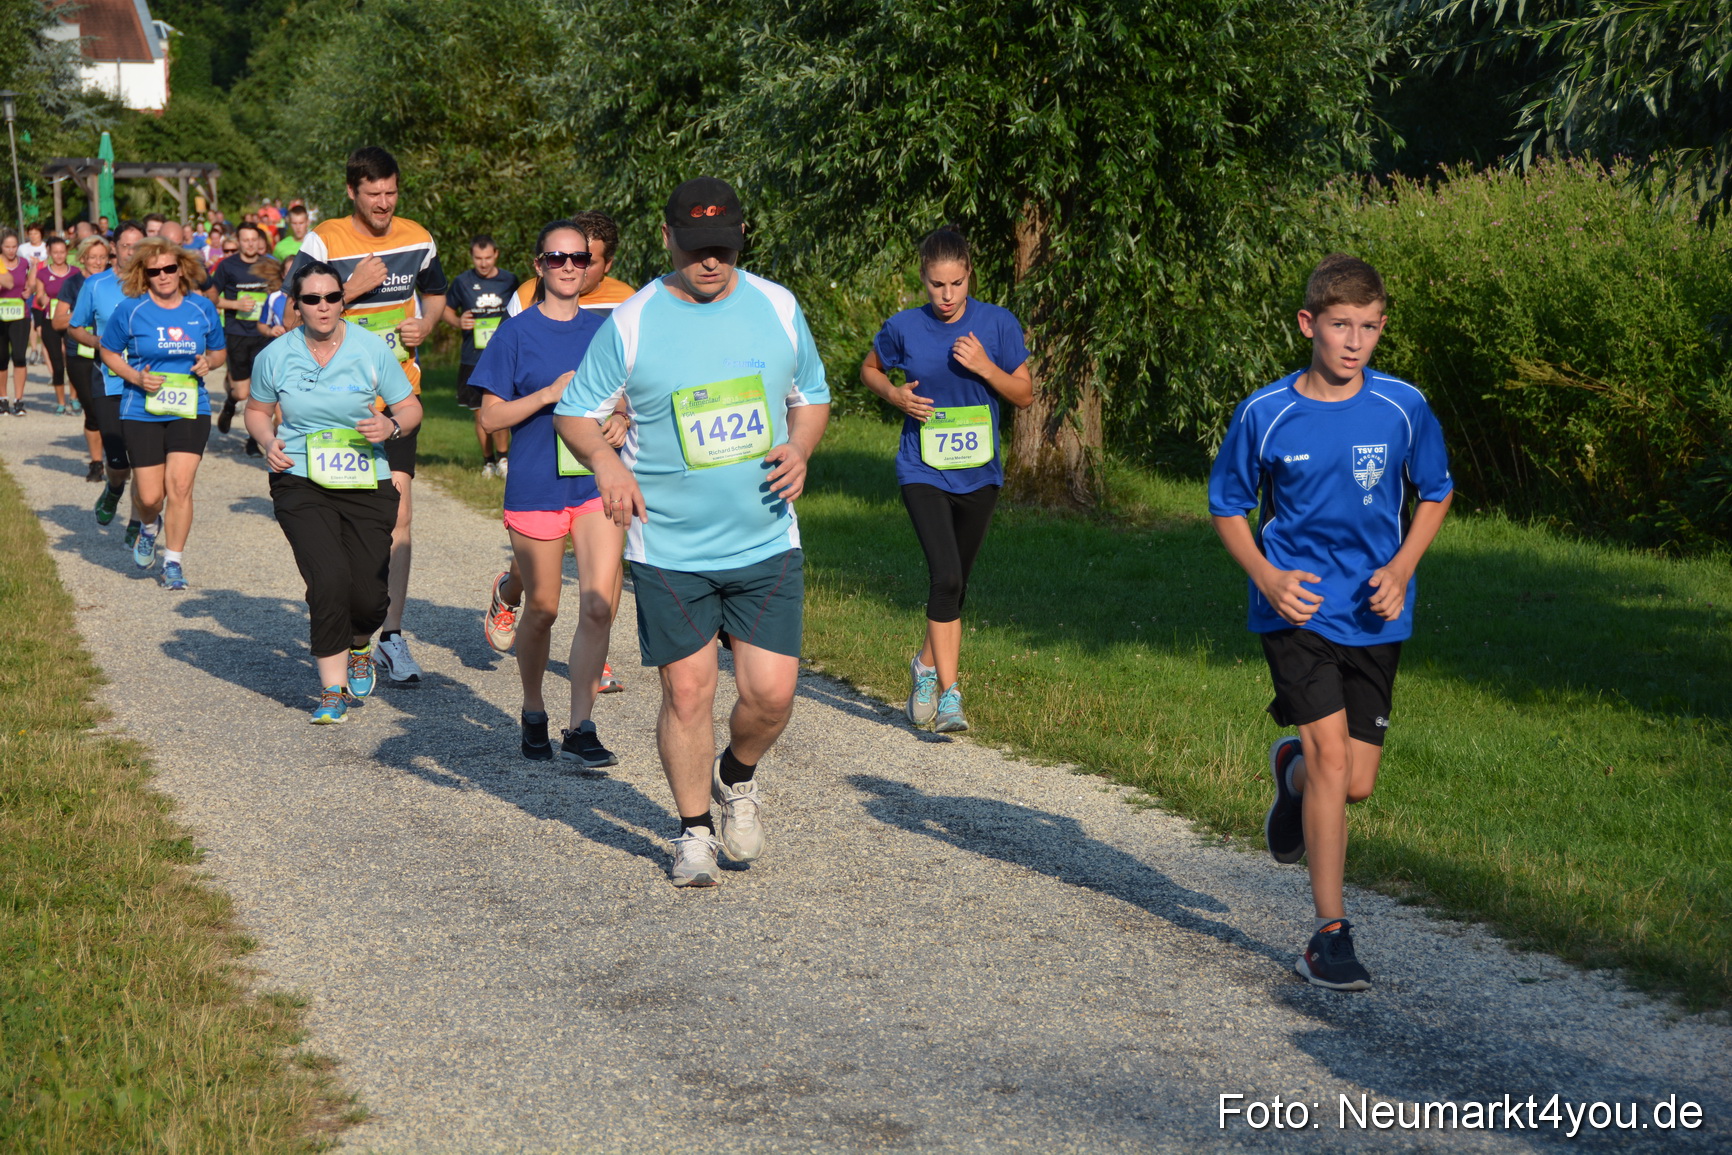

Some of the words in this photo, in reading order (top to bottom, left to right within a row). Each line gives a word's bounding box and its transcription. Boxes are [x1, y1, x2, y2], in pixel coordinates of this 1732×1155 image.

[383, 273, 414, 286] cher
[370, 285, 411, 294] UTOMOBILE
[158, 340, 197, 351] camping
[156, 390, 188, 406] 492
[689, 408, 765, 447] 1424
[934, 431, 979, 453] 758
[708, 447, 731, 456] Richard
[731, 443, 754, 452] Schmidt
[316, 452, 370, 472] 1426
[1292, 453, 1310, 462] JAKO
